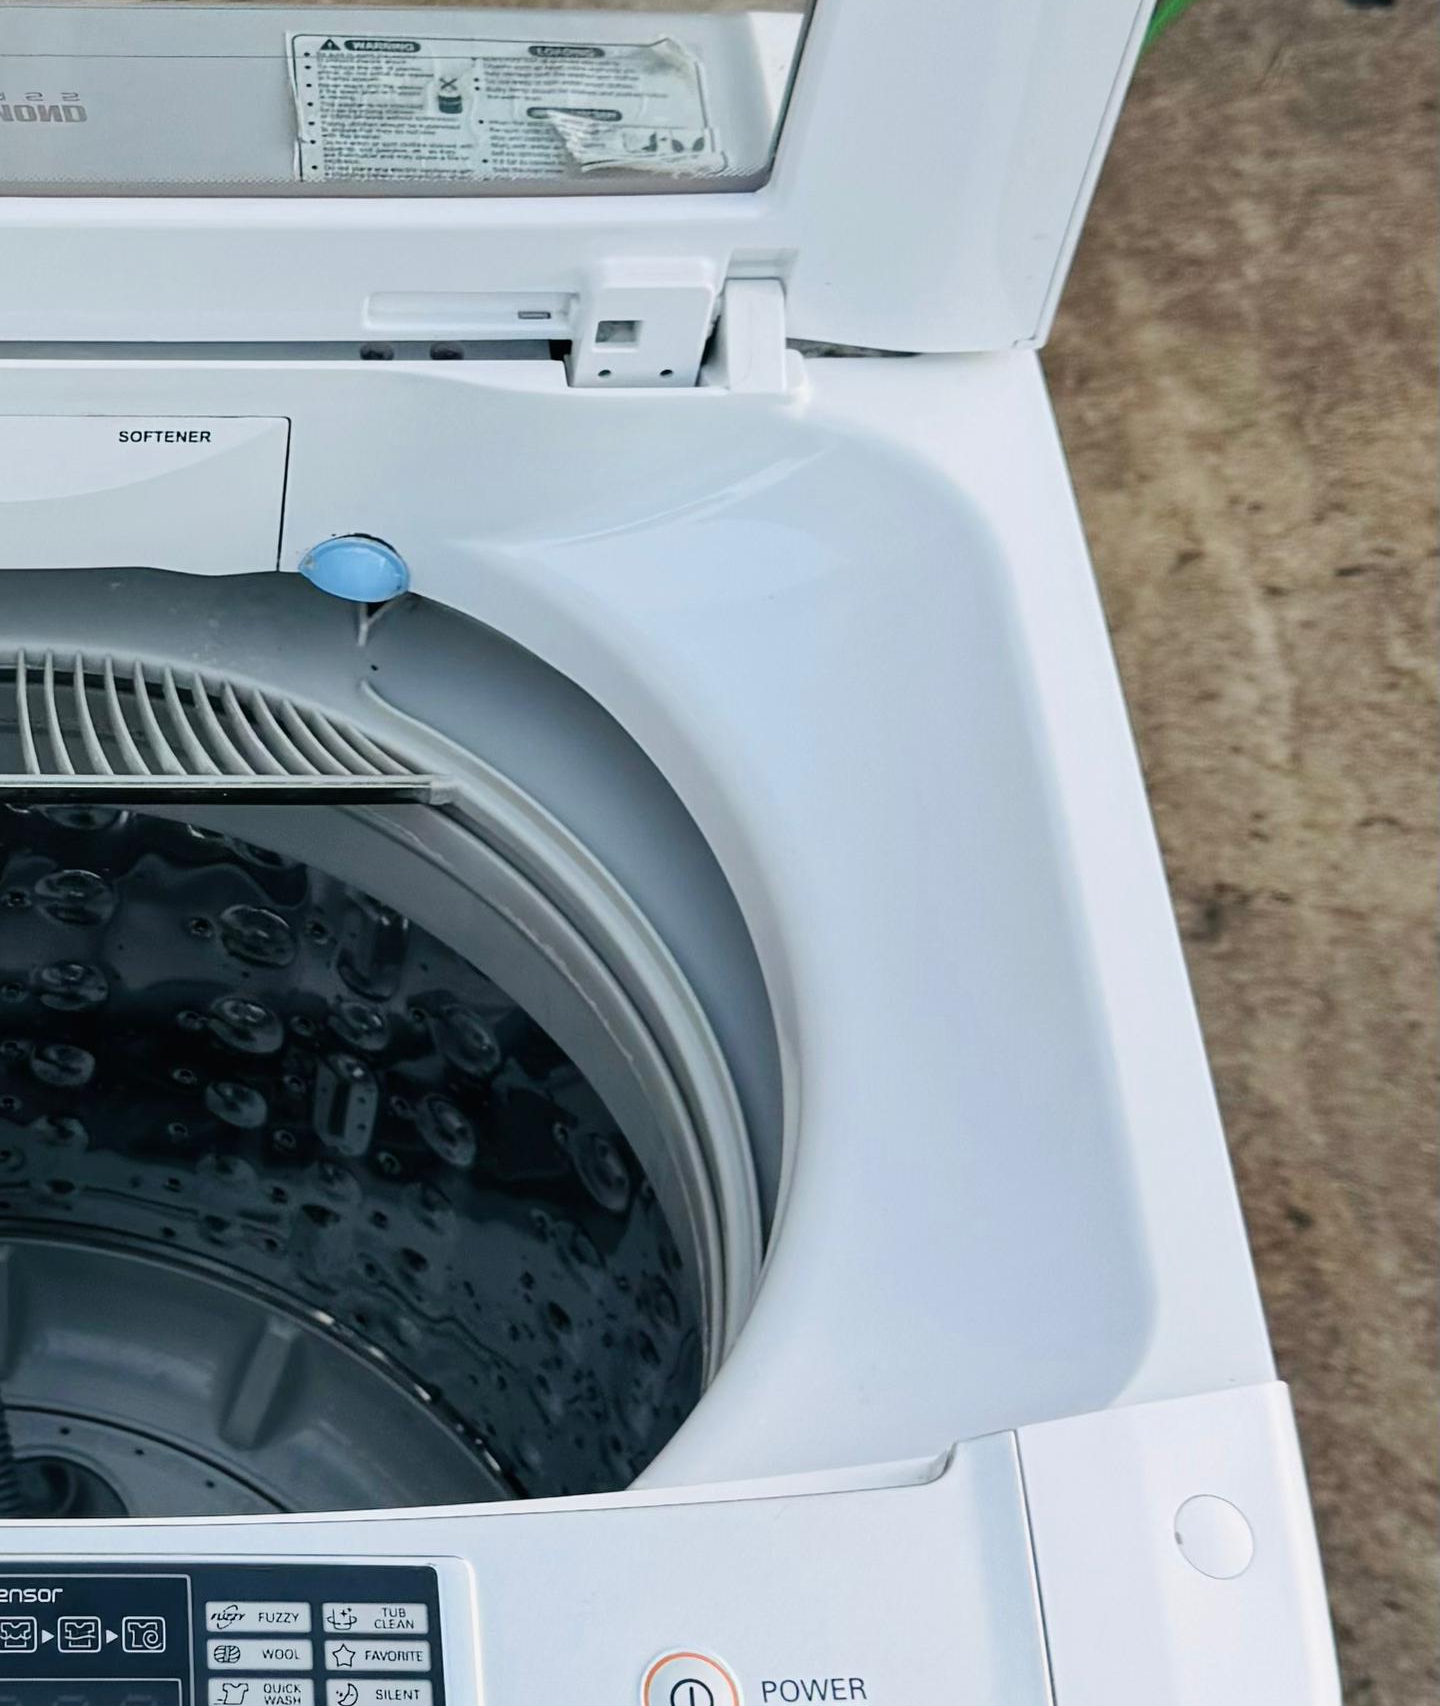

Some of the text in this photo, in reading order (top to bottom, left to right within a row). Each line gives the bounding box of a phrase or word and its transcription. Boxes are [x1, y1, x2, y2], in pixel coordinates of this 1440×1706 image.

[117, 428, 212, 444] SOFTENER
[258, 1612, 300, 1623] FUZZY
[381, 1607, 407, 1618] TUB
[373, 1619, 415, 1630] CLEAN
[262, 1649, 301, 1660] WOOL
[364, 1650, 424, 1662] FAVORITE
[263, 1683, 302, 1694] QUICK
[761, 1677, 868, 1703] POWER
[264, 1695, 302, 1706] WASH
[375, 1689, 420, 1701] SILENT
